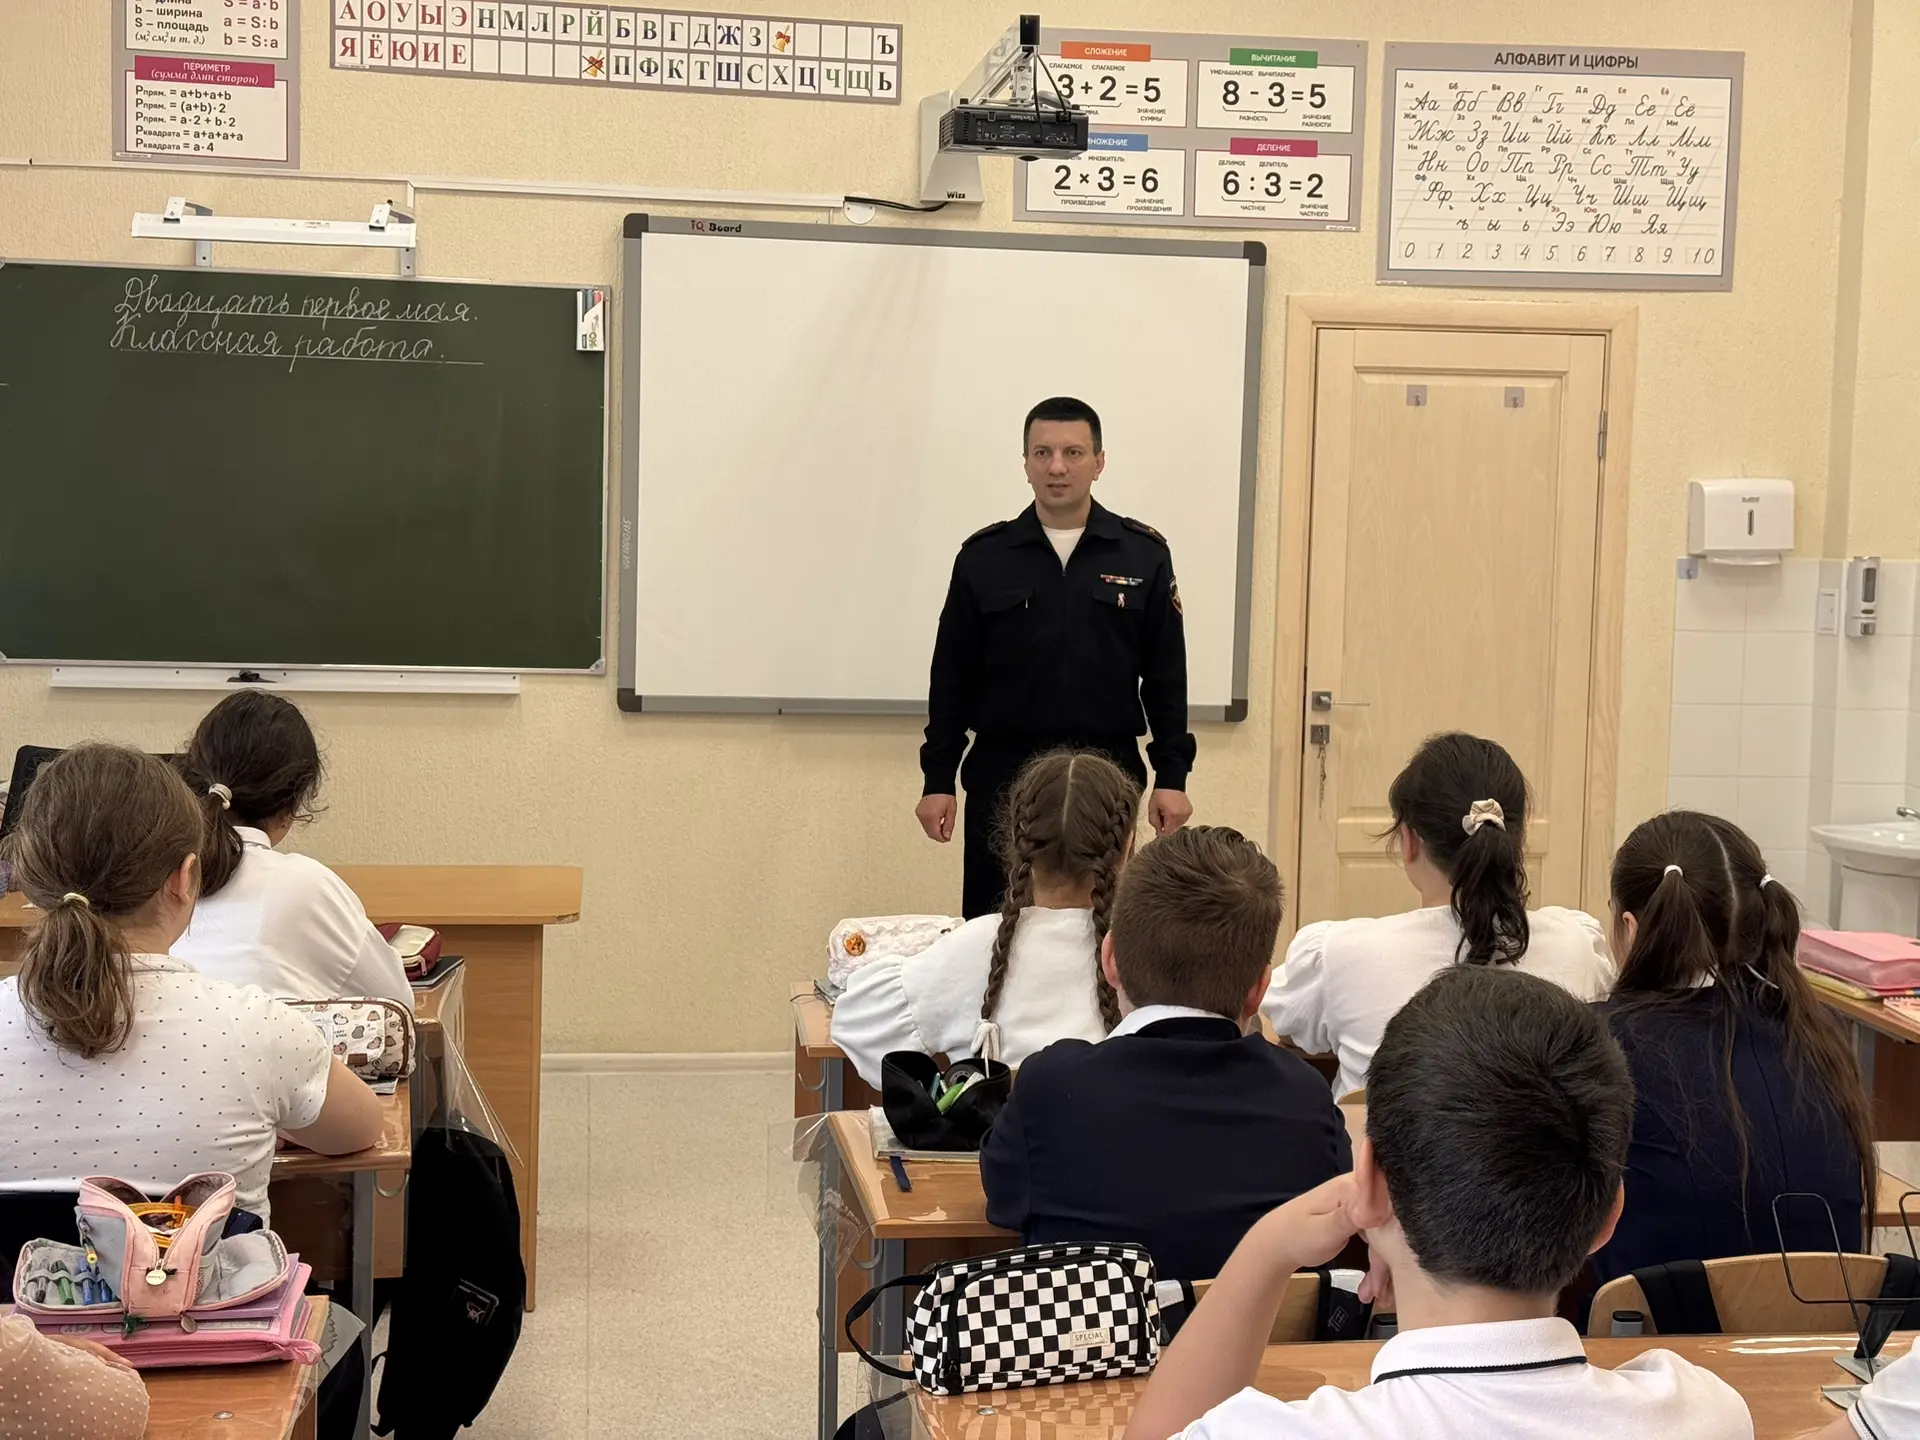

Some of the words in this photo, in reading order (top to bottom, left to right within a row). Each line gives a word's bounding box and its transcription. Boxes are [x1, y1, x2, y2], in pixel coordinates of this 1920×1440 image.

[156, 8, 203, 18] ширина
[157, 20, 210, 32] площадь
[340, 0, 356, 20] А
[368, 2, 385, 22] О
[398, 2, 413, 23] У
[420, 4, 443, 26] Ы
[452, 6, 468, 26] Э
[478, 8, 496, 29] Н
[503, 10, 525, 31] М
[531, 12, 550, 32] Л
[561, 14, 576, 34] Р
[586, 10, 604, 36] Й
[616, 18, 630, 38] Б
[642, 20, 657, 40] В
[669, 22, 684, 42] Г
[694, 23, 712, 48] Д
[718, 25, 740, 46] Ж
[749, 26, 762, 46] З
[878, 34, 894, 55] Ъ
[1084, 47, 1128, 56] СЛОЖЕНИЕ
[1251, 54, 1296, 63] ВЫЧИТАНИЕ
[1494, 52, 1566, 66] АЛФАВИТ
[1570, 54, 1580, 67] И
[1584, 55, 1638, 70] ЦИФРЫ
[183, 62, 231, 72] ПЕРИМЕТР
[340, 37, 357, 58] Я
[368, 34, 384, 59] Ё
[392, 40, 417, 61] Ю
[422, 42, 442, 62] И
[452, 44, 467, 64] Е
[614, 56, 631, 76] П
[639, 57, 659, 78] Ф
[667, 59, 684, 79] К
[694, 60, 710, 80] Т
[717, 62, 740, 82] Ш
[746, 64, 764, 84] С
[772, 65, 789, 86] Х
[799, 68, 817, 90] Ц
[826, 68, 842, 88] Ч
[848, 70, 871, 96] Щ
[878, 72, 892, 91] Ь
[1049, 62, 1083, 70] СЛАГАЕМОЕ
[1092, 64, 1126, 72] СЛАГАЕМОЕ
[151, 69, 188, 80] (сумма
[190, 71, 214, 81] длин
[216, 75, 259, 85] сторон)
[1210, 68, 1254, 76] УМЕНЬШАЕМОЕ
[1256, 144, 1292, 152] ДЕЛЕНИЕ
[1060, 198, 1106, 206] ПРОИЗВЕДЕНИЕ
[708, 222, 742, 232] Board
[1404, 242, 1416, 258] 0
[1436, 242, 1444, 258] 1
[1462, 243, 1473, 260] 2
[1491, 244, 1502, 260] 3
[1520, 244, 1530, 260] 4
[1546, 244, 1558, 261] 5
[1576, 246, 1588, 262] 6
[1605, 246, 1616, 262] 7
[1634, 246, 1645, 262] 8
[1662, 247, 1673, 264] 9
[1692, 248, 1715, 264] 10
[114, 274, 290, 328] Двадцать
[301, 286, 390, 331] первое
[110, 310, 283, 355] Классная
[1074, 332, 1104, 342] SPECIAL
